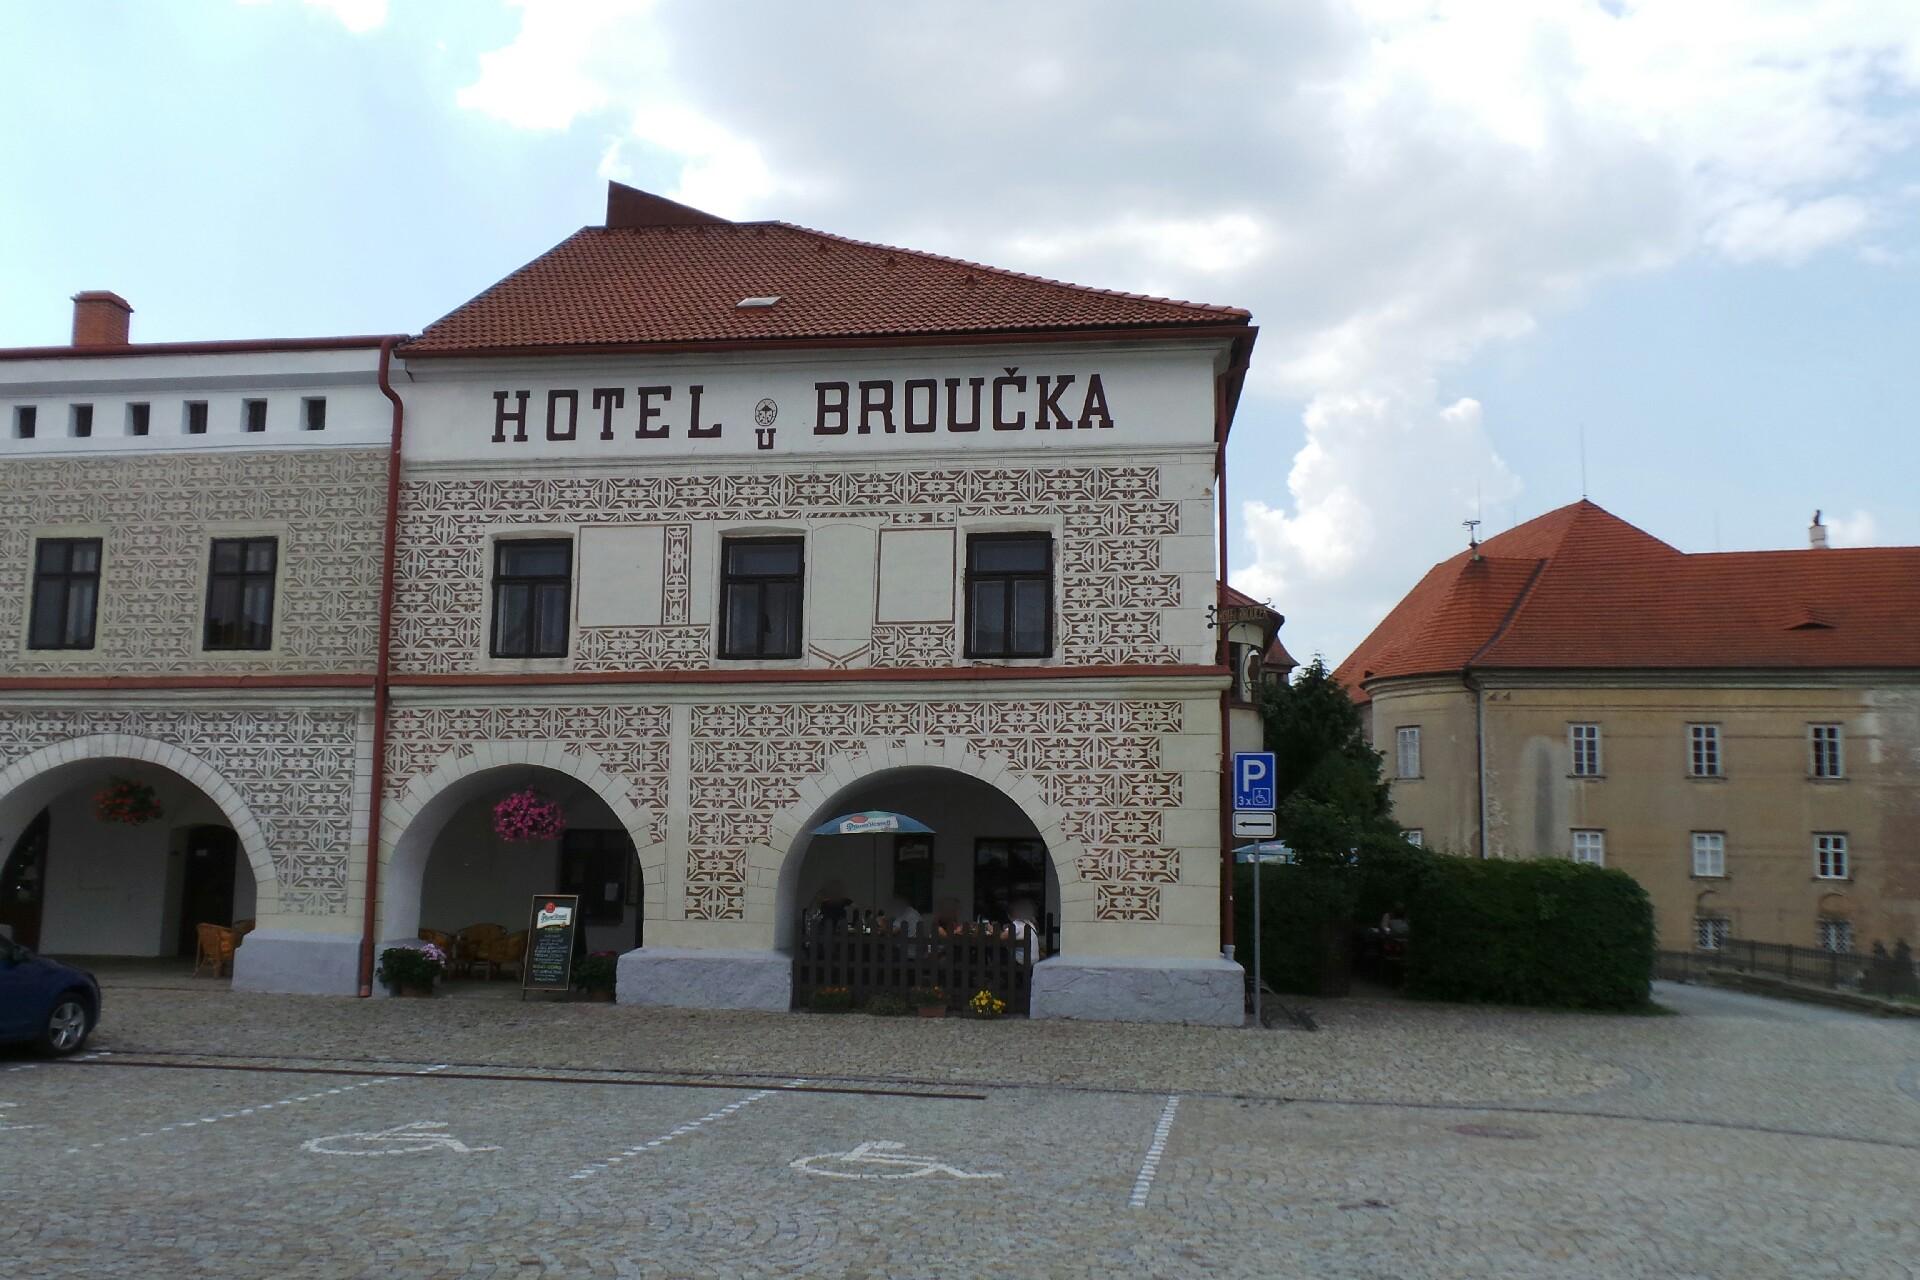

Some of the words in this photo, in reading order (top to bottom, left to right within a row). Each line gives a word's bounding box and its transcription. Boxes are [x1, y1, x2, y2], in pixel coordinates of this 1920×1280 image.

[492, 385, 722, 443] HOTEL
[755, 428, 777, 450] U
[814, 367, 1114, 436] BROUČKA
[1243, 760, 1266, 792] P
